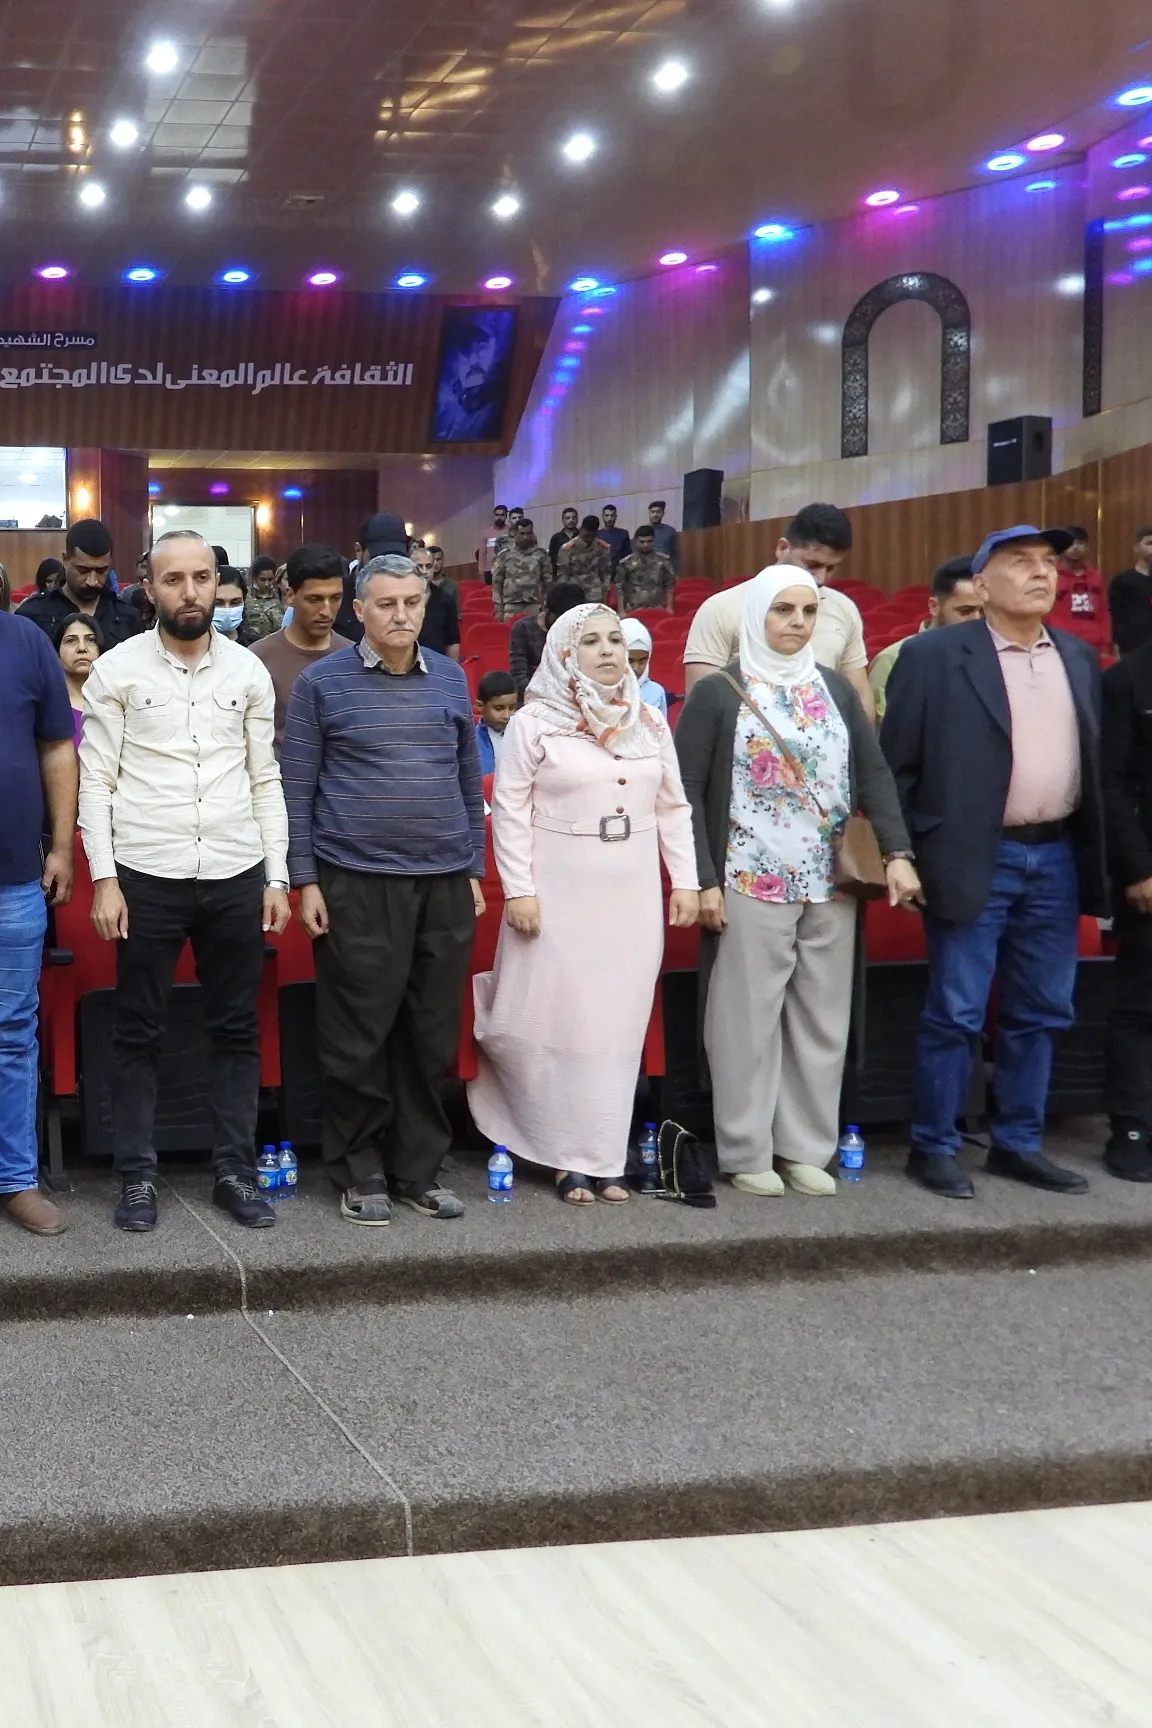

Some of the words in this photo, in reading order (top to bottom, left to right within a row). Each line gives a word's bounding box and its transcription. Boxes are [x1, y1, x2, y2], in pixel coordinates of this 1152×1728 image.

[53, 332, 95, 348] مسرح
[0, 361, 108, 389] المجتمع
[165, 362, 255, 390] المعنى
[251, 362, 308, 396] عالم
[311, 361, 414, 386] الثقافة
